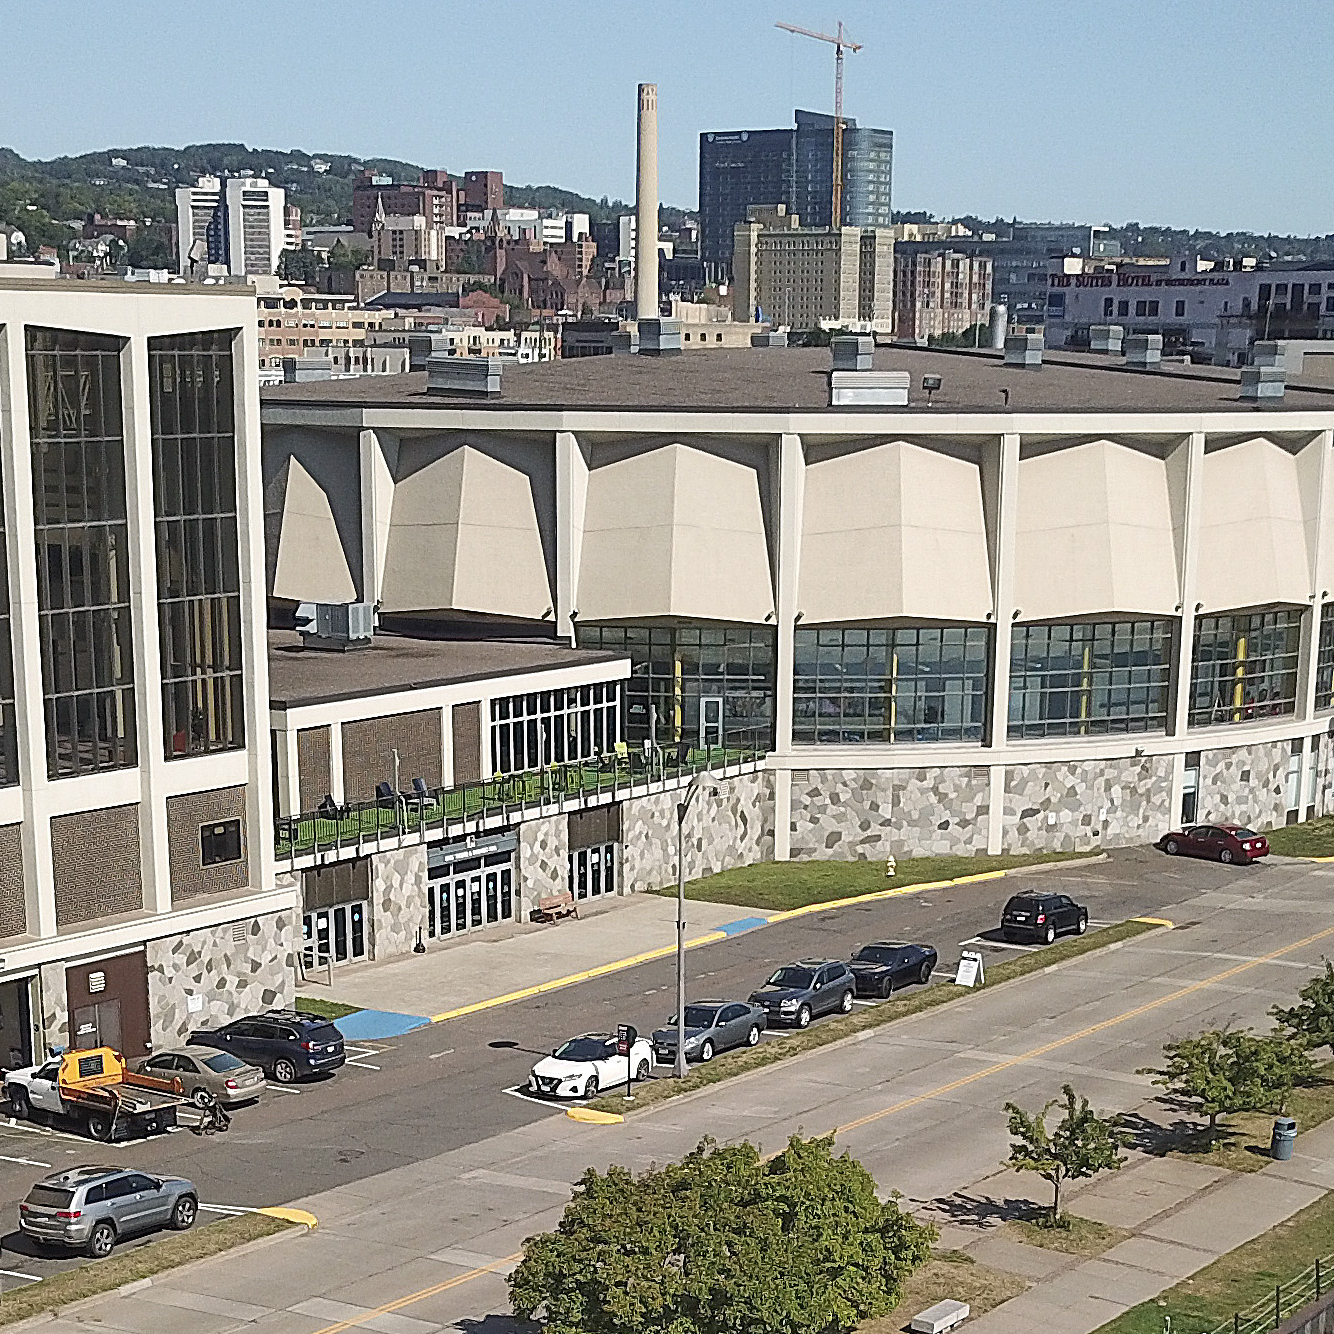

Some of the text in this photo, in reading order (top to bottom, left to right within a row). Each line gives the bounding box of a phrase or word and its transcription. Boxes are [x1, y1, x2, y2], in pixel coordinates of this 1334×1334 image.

[1049, 274, 1071, 287] THE
[1075, 274, 1113, 287] SUITES
[1116, 273, 1154, 287] HOTEL
